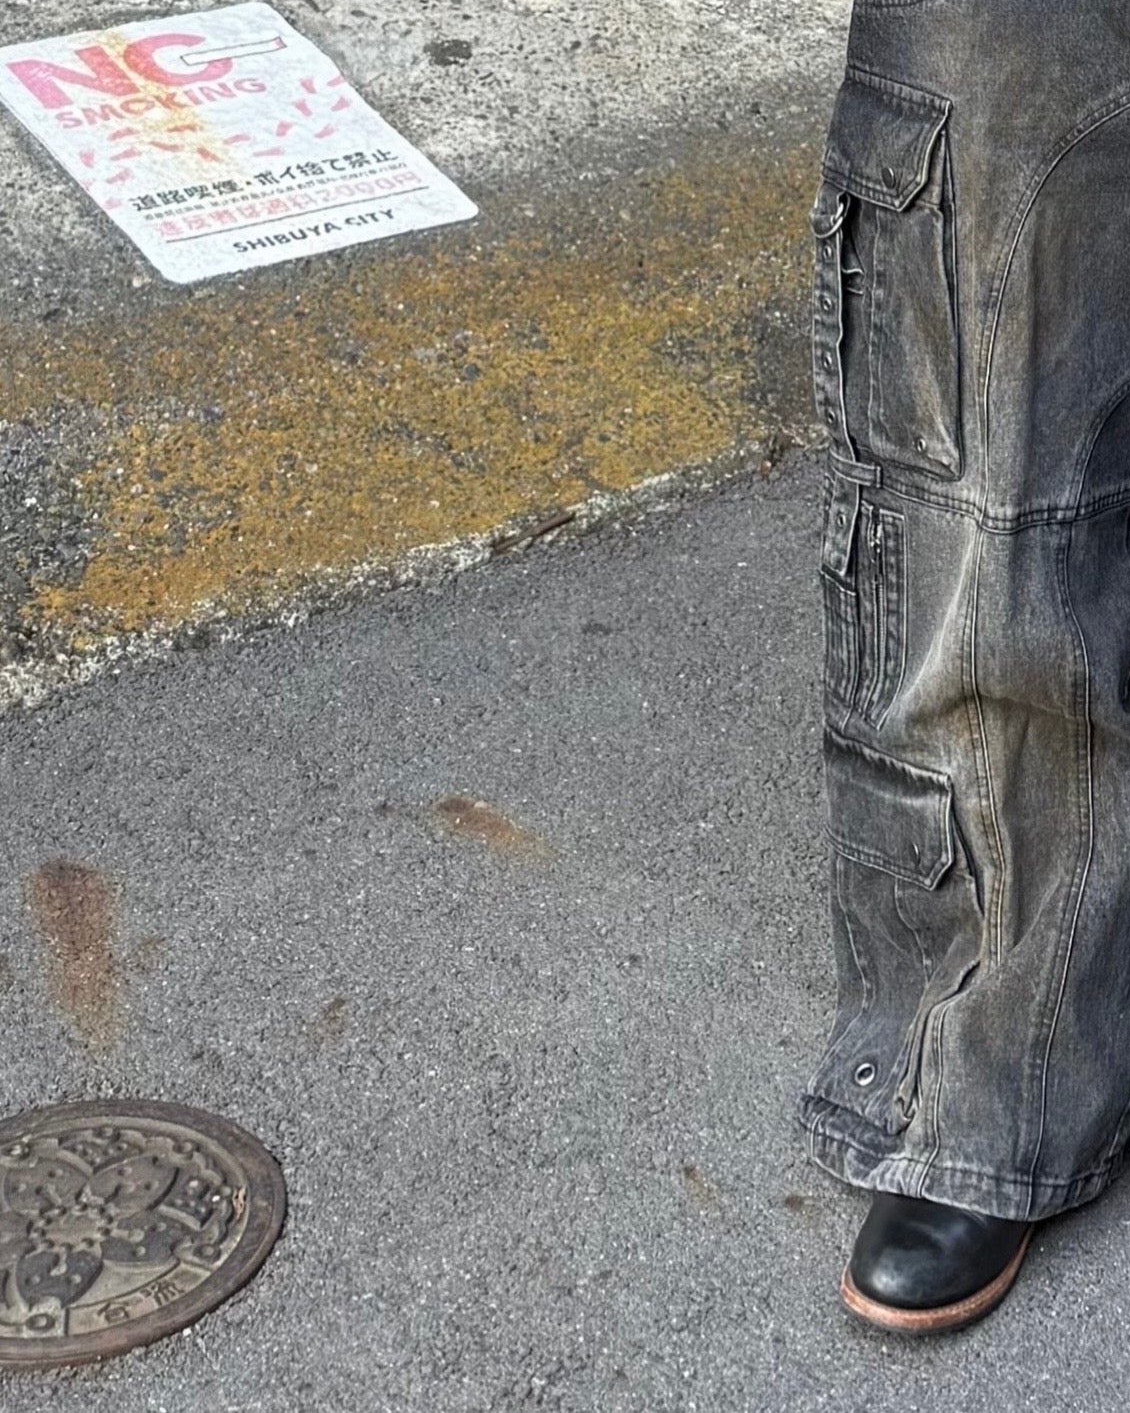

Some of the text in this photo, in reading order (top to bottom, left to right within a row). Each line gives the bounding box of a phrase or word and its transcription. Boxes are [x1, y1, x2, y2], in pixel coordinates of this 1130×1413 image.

[55, 78, 267, 128] SMOKING
[232, 208, 396, 254] SHIBUYA CITY
